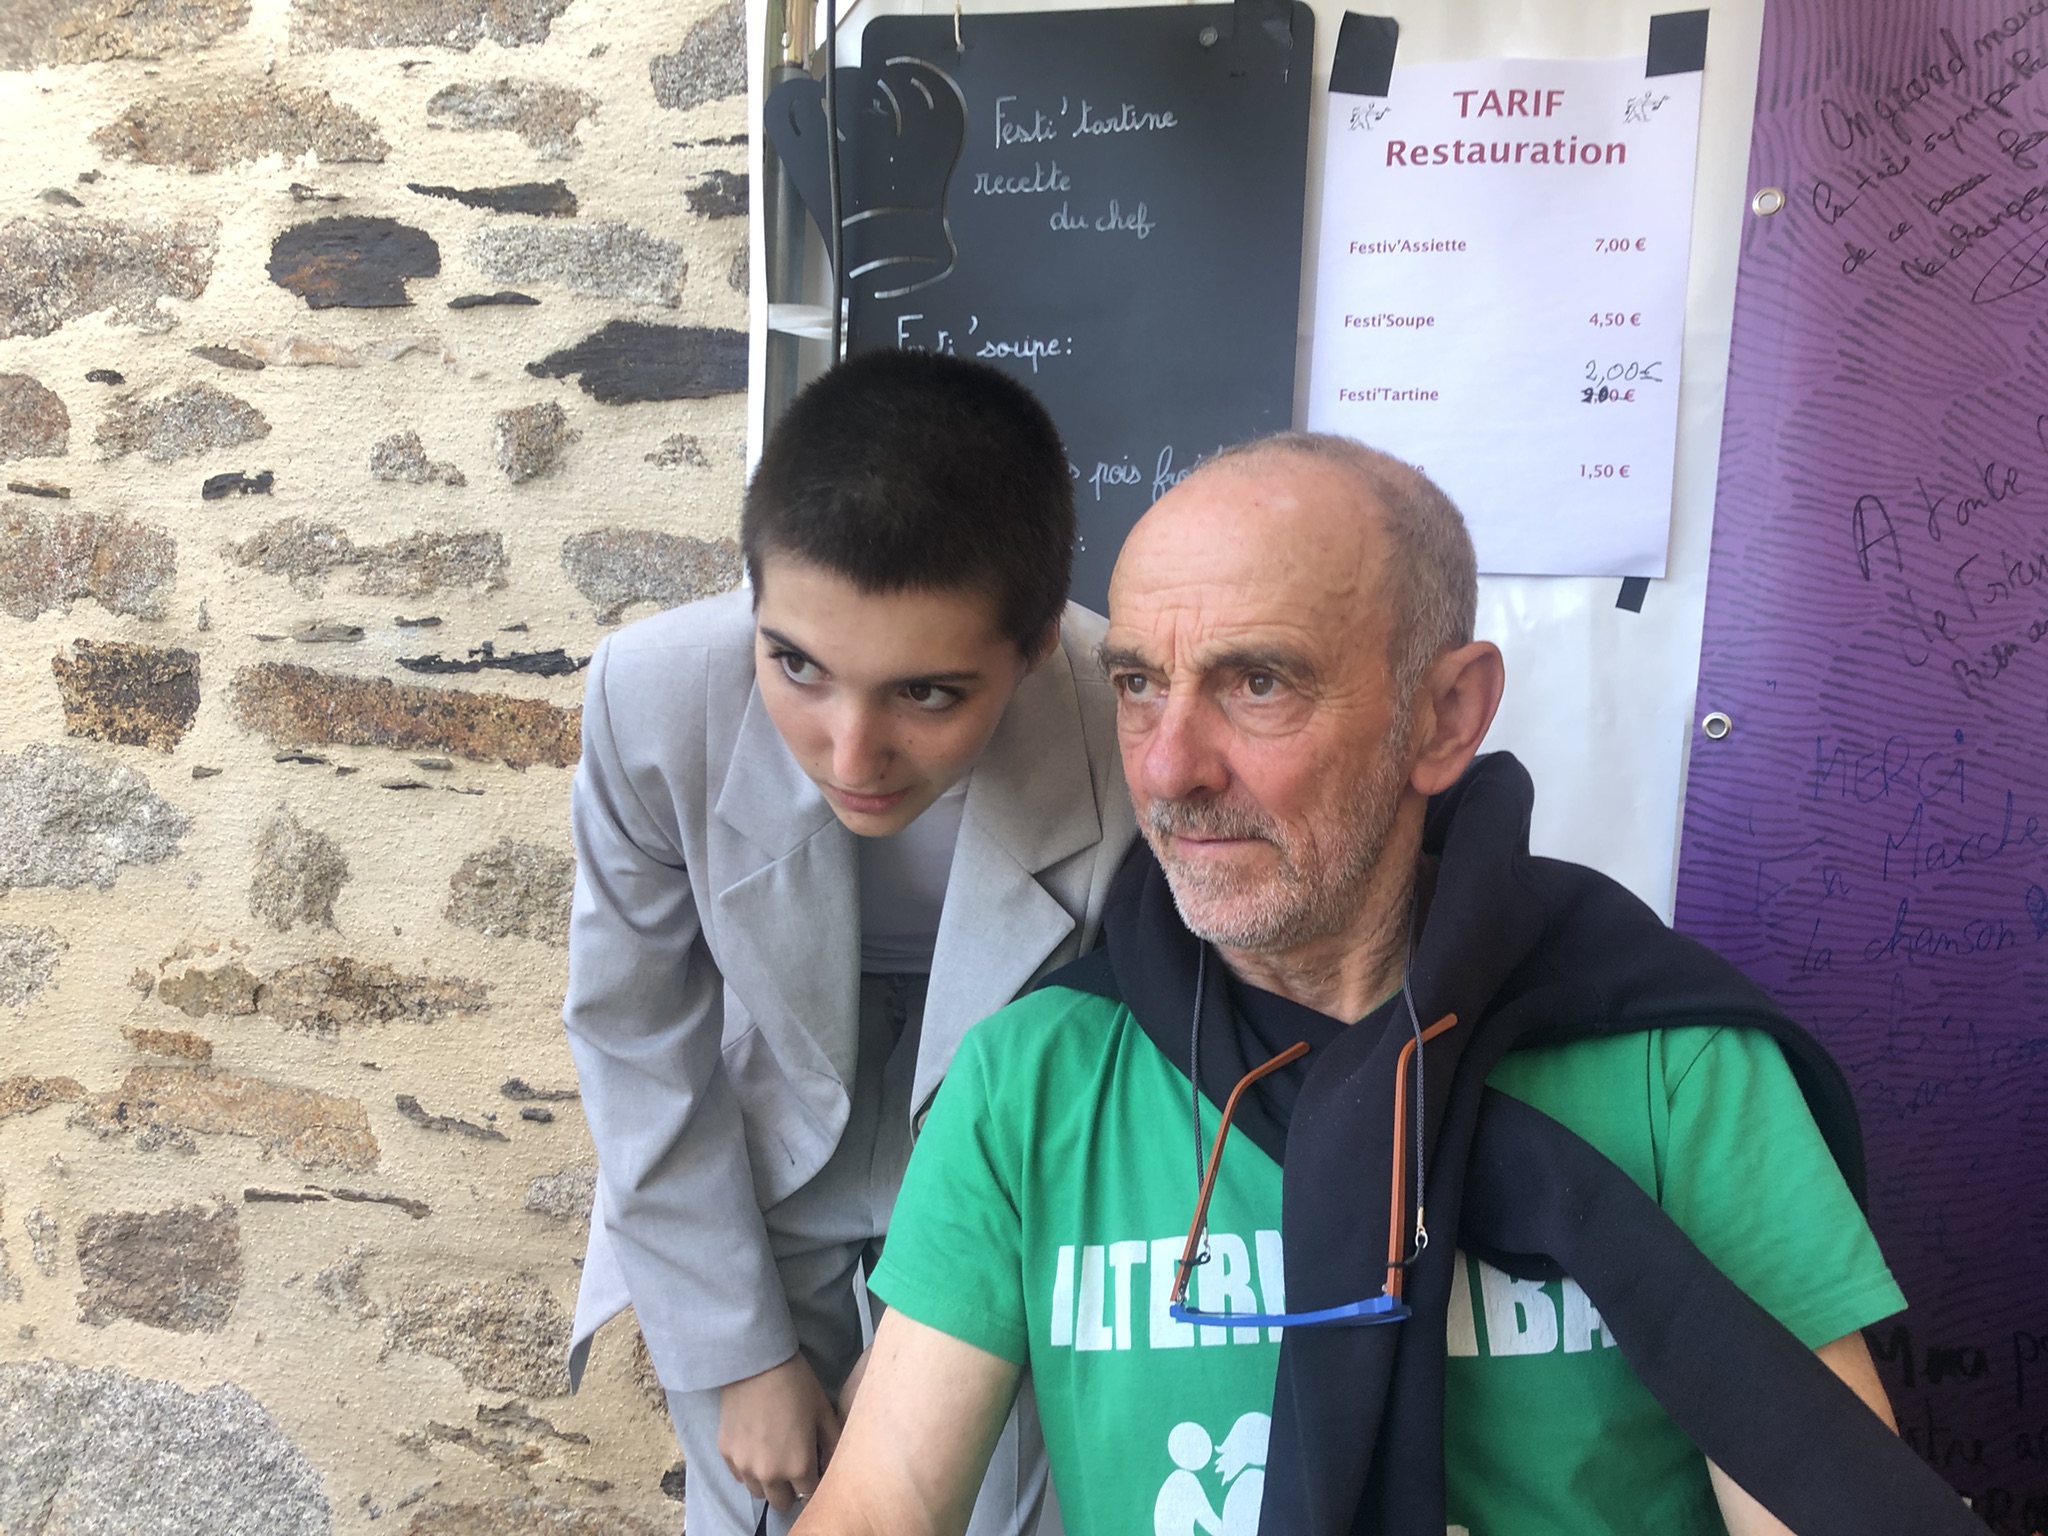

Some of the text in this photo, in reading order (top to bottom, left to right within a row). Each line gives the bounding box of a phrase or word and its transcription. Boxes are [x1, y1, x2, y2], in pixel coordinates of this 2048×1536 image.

[1452, 88, 1566, 118] TARIF
[1385, 134, 1628, 168] Restauration
[974, 160, 1071, 195] recette
[1050, 199, 1156, 239] du chef
[1349, 237, 1467, 255] Festiv'Assiette
[1595, 237, 1647, 254] 7,00 €
[1344, 312, 1435, 330] Festi'Soupe
[1588, 312, 1642, 329] 4,50 €
[1339, 386, 1439, 402] Festi'Tartine
[1088, 455, 1142, 501] pois
[1580, 463, 1631, 480] 1,50 €
[1864, 897, 2017, 965] chanson
